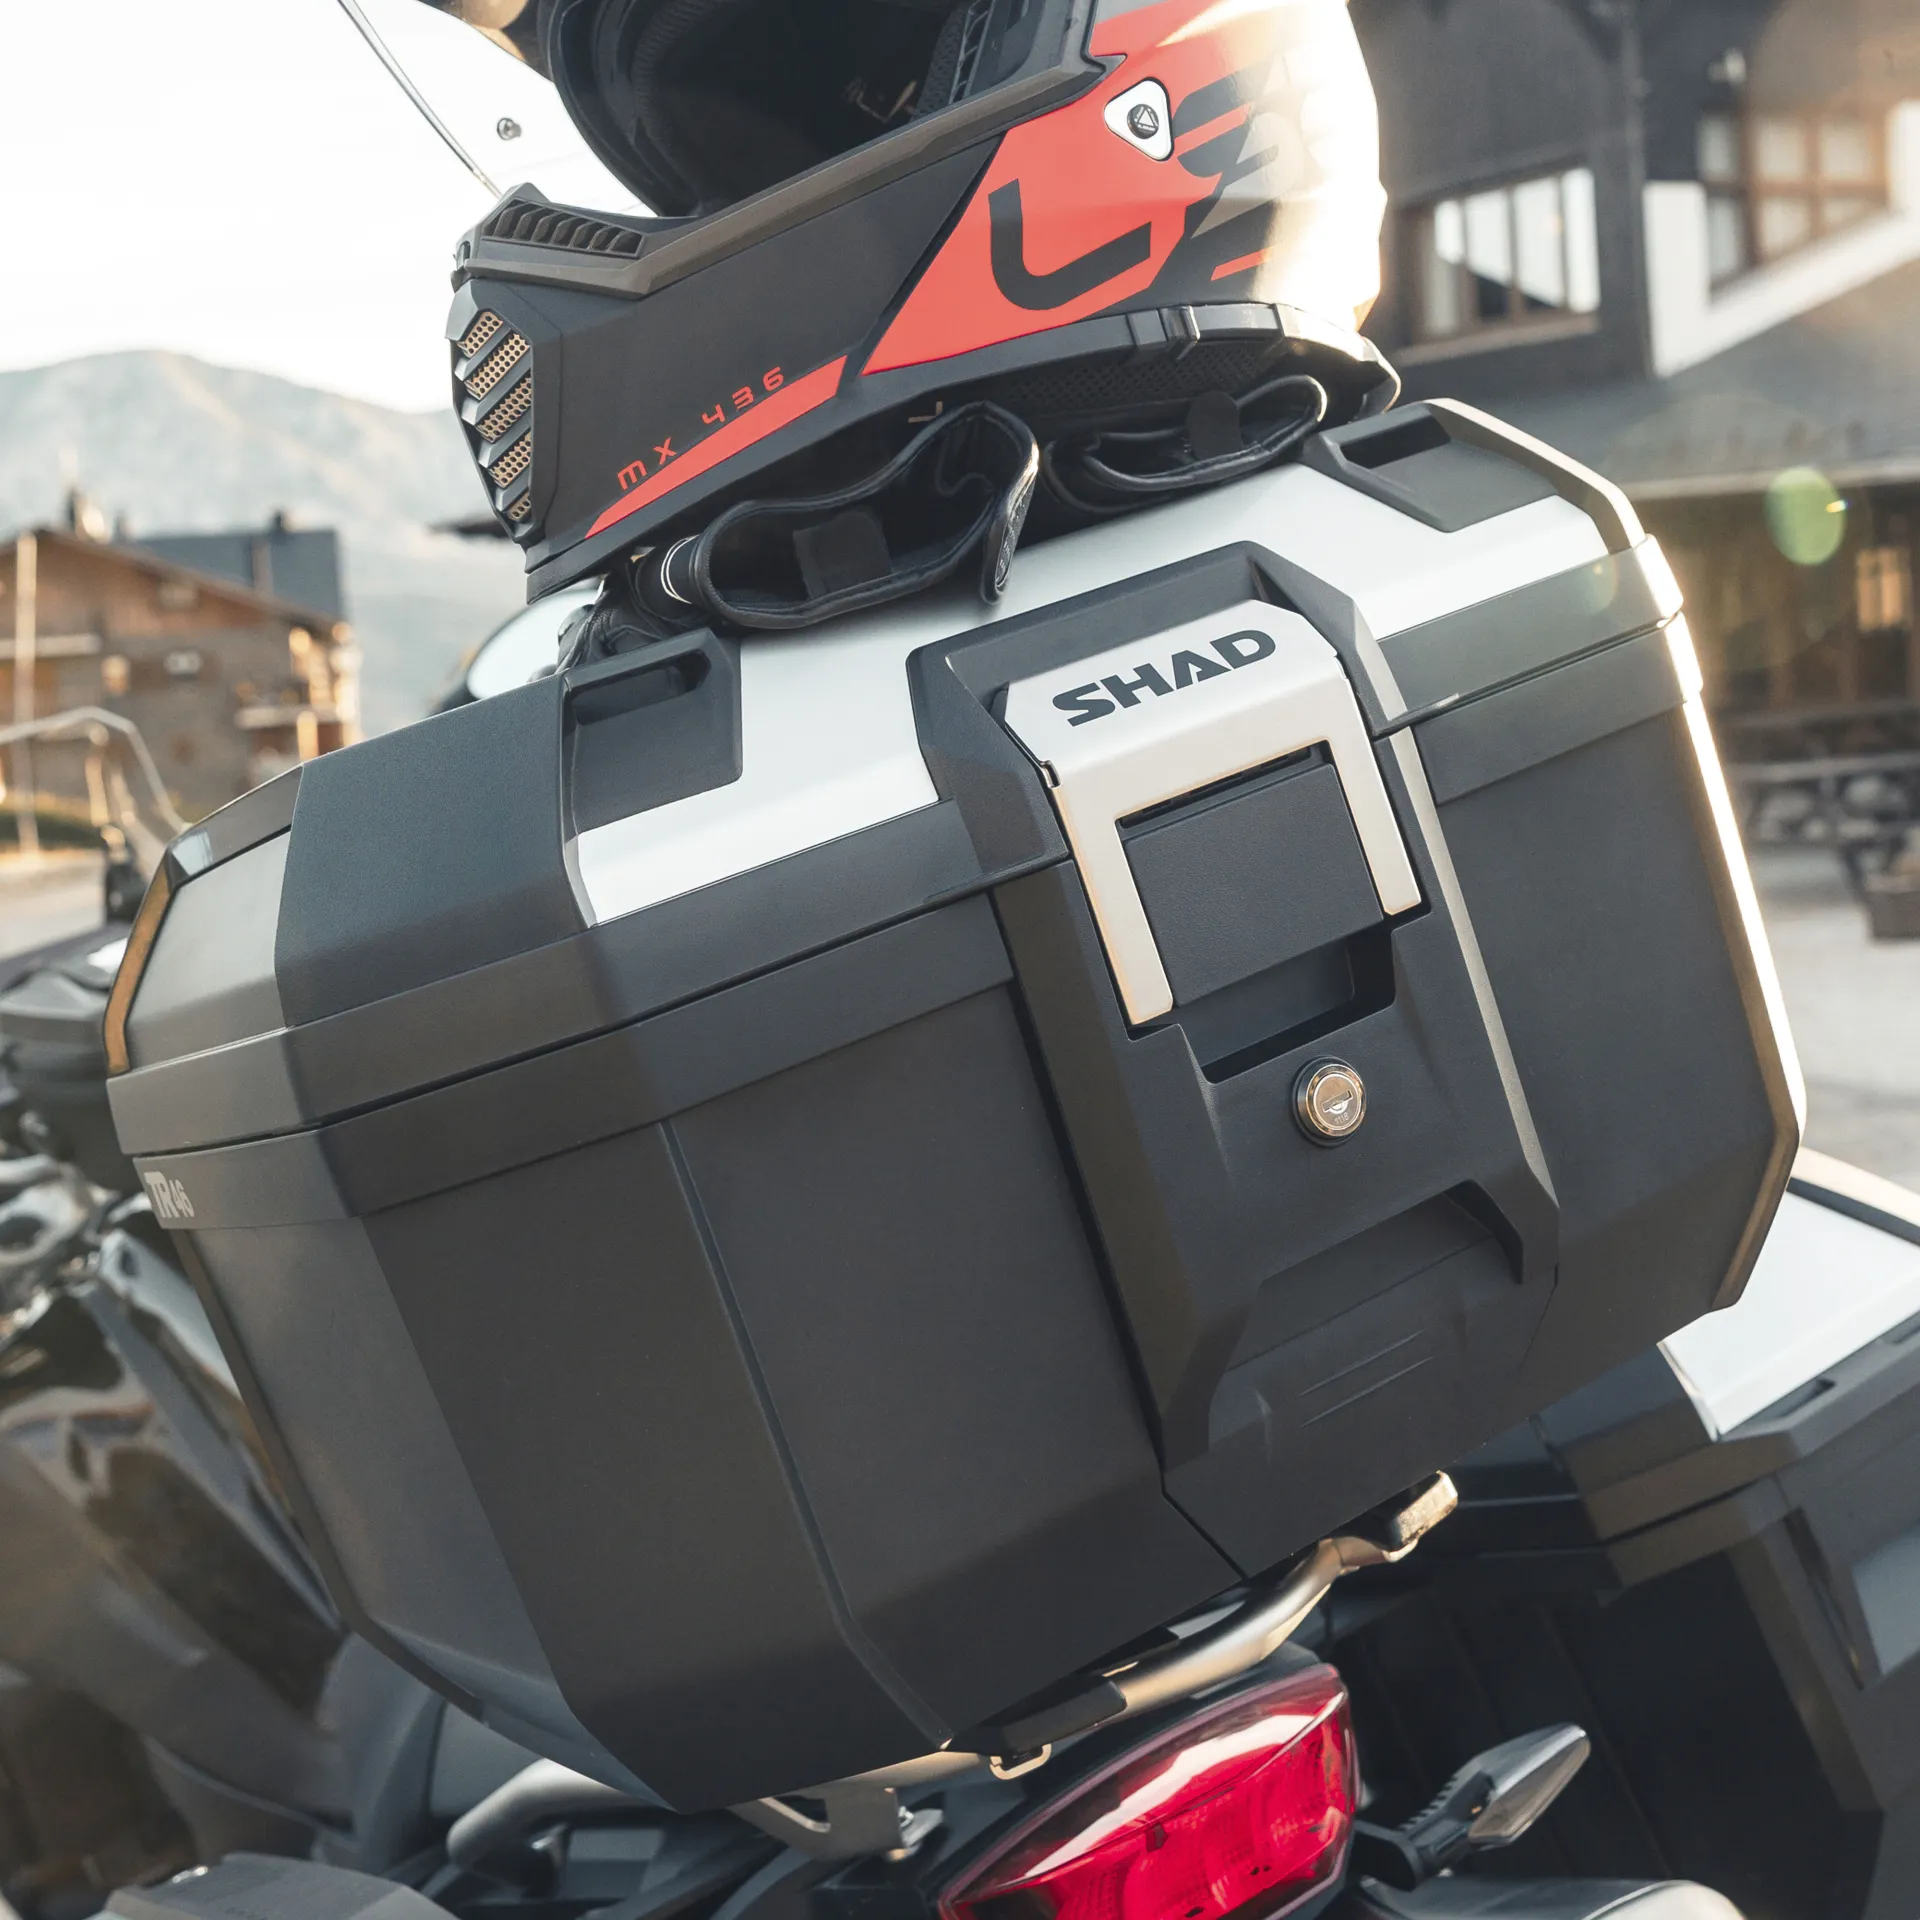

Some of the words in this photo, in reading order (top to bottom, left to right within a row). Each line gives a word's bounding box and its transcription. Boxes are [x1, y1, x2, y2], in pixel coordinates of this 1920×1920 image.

[616, 436, 677, 490] MX
[701, 366, 784, 424] 436
[1052, 629, 1276, 727] SHAD
[143, 1170, 195, 1218] TR46
